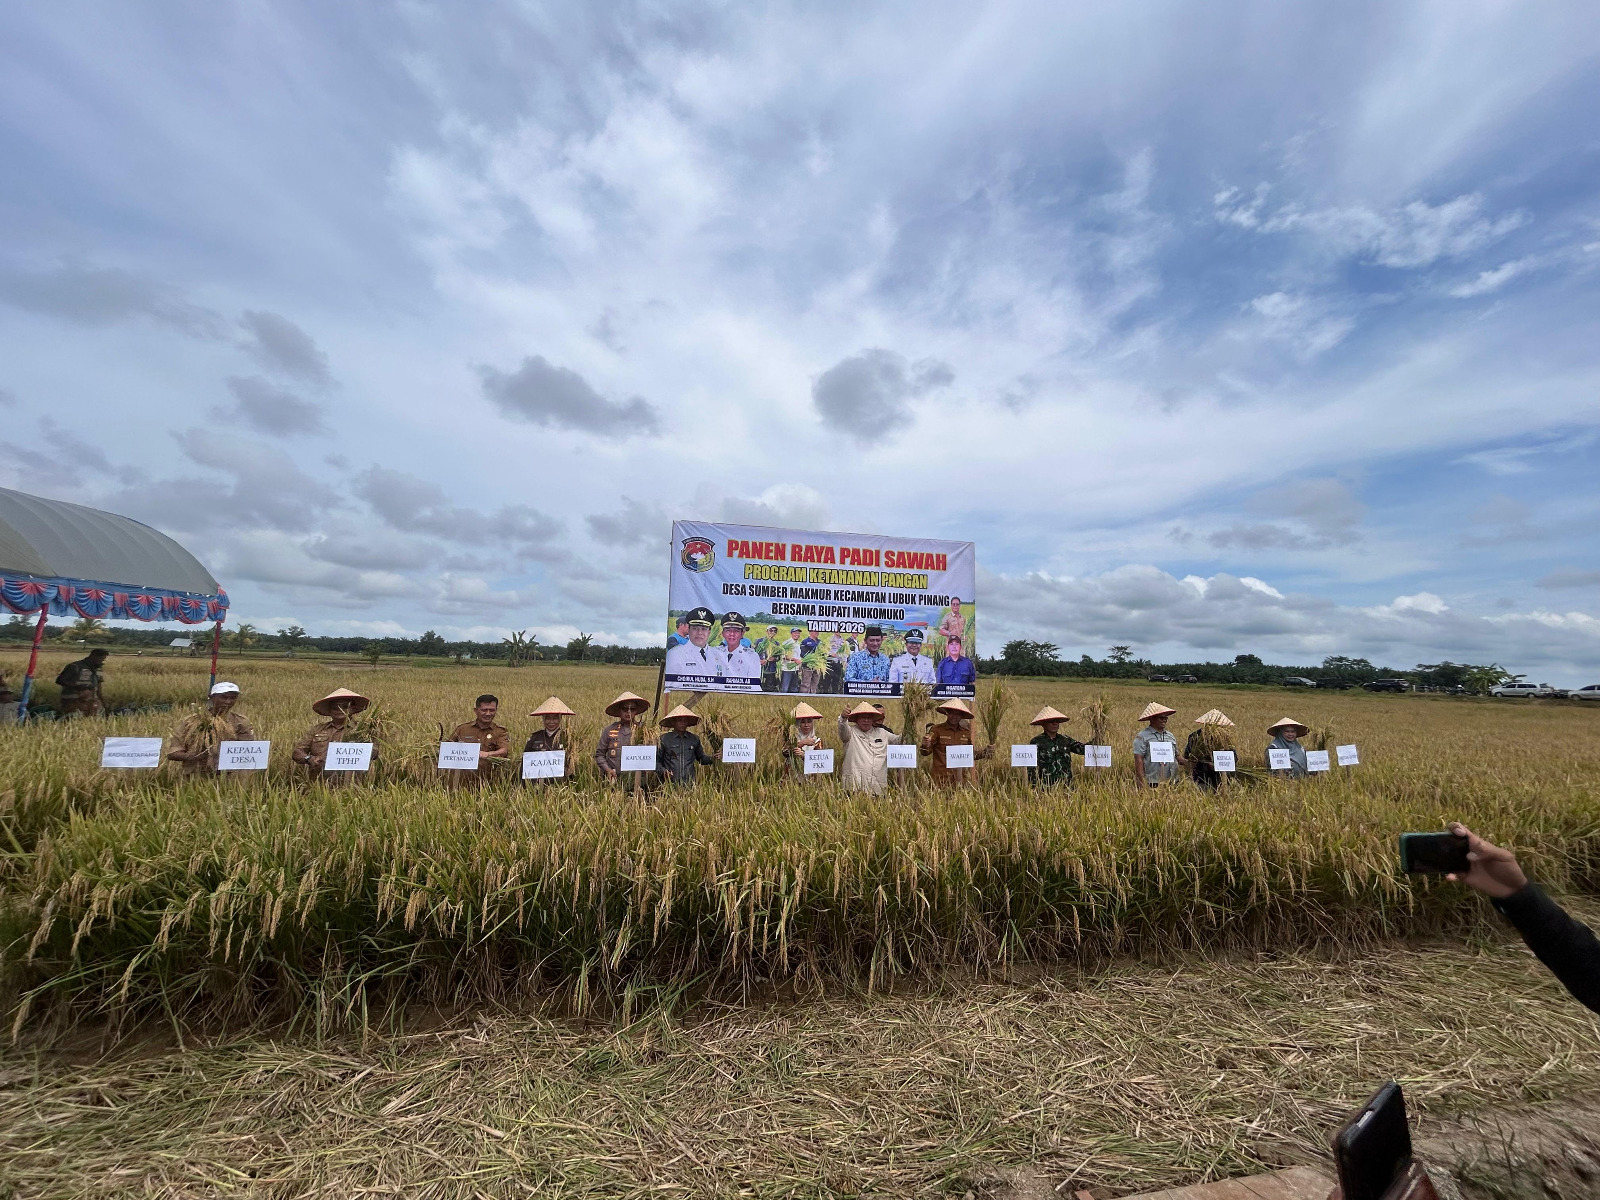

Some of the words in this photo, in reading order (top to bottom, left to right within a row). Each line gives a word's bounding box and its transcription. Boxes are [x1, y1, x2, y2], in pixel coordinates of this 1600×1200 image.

[727, 539, 786, 561] PANEN
[790, 543, 836, 564] RAYA
[839, 547, 880, 567] PADI
[884, 550, 947, 571] SAWAH
[744, 563, 807, 582] PROGRAM
[809, 567, 879, 586] KETAHANAN
[880, 571, 928, 589] PANGAN
[722, 583, 746, 596] DESA
[748, 584, 788, 599] SUMBER
[789, 586, 832, 601] MAKMUR
[833, 589, 886, 604] KECAMATAN
[888, 592, 917, 605] LUBUK
[918, 594, 950, 607] PINANG
[771, 602, 816, 616] BERSAMA
[818, 604, 851, 618] BUPATI
[852, 606, 905, 620] MUKOMUKO
[806, 619, 839, 632] TAHUN
[839, 621, 865, 634] 2026
[226, 746, 262, 755] KEPALA
[335, 747, 364, 755] KADIS
[231, 756, 256, 764] DESA
[890, 752, 913, 760] BUPATI
[336, 757, 360, 765] TPHP
[530, 758, 561, 767] KAJARI
